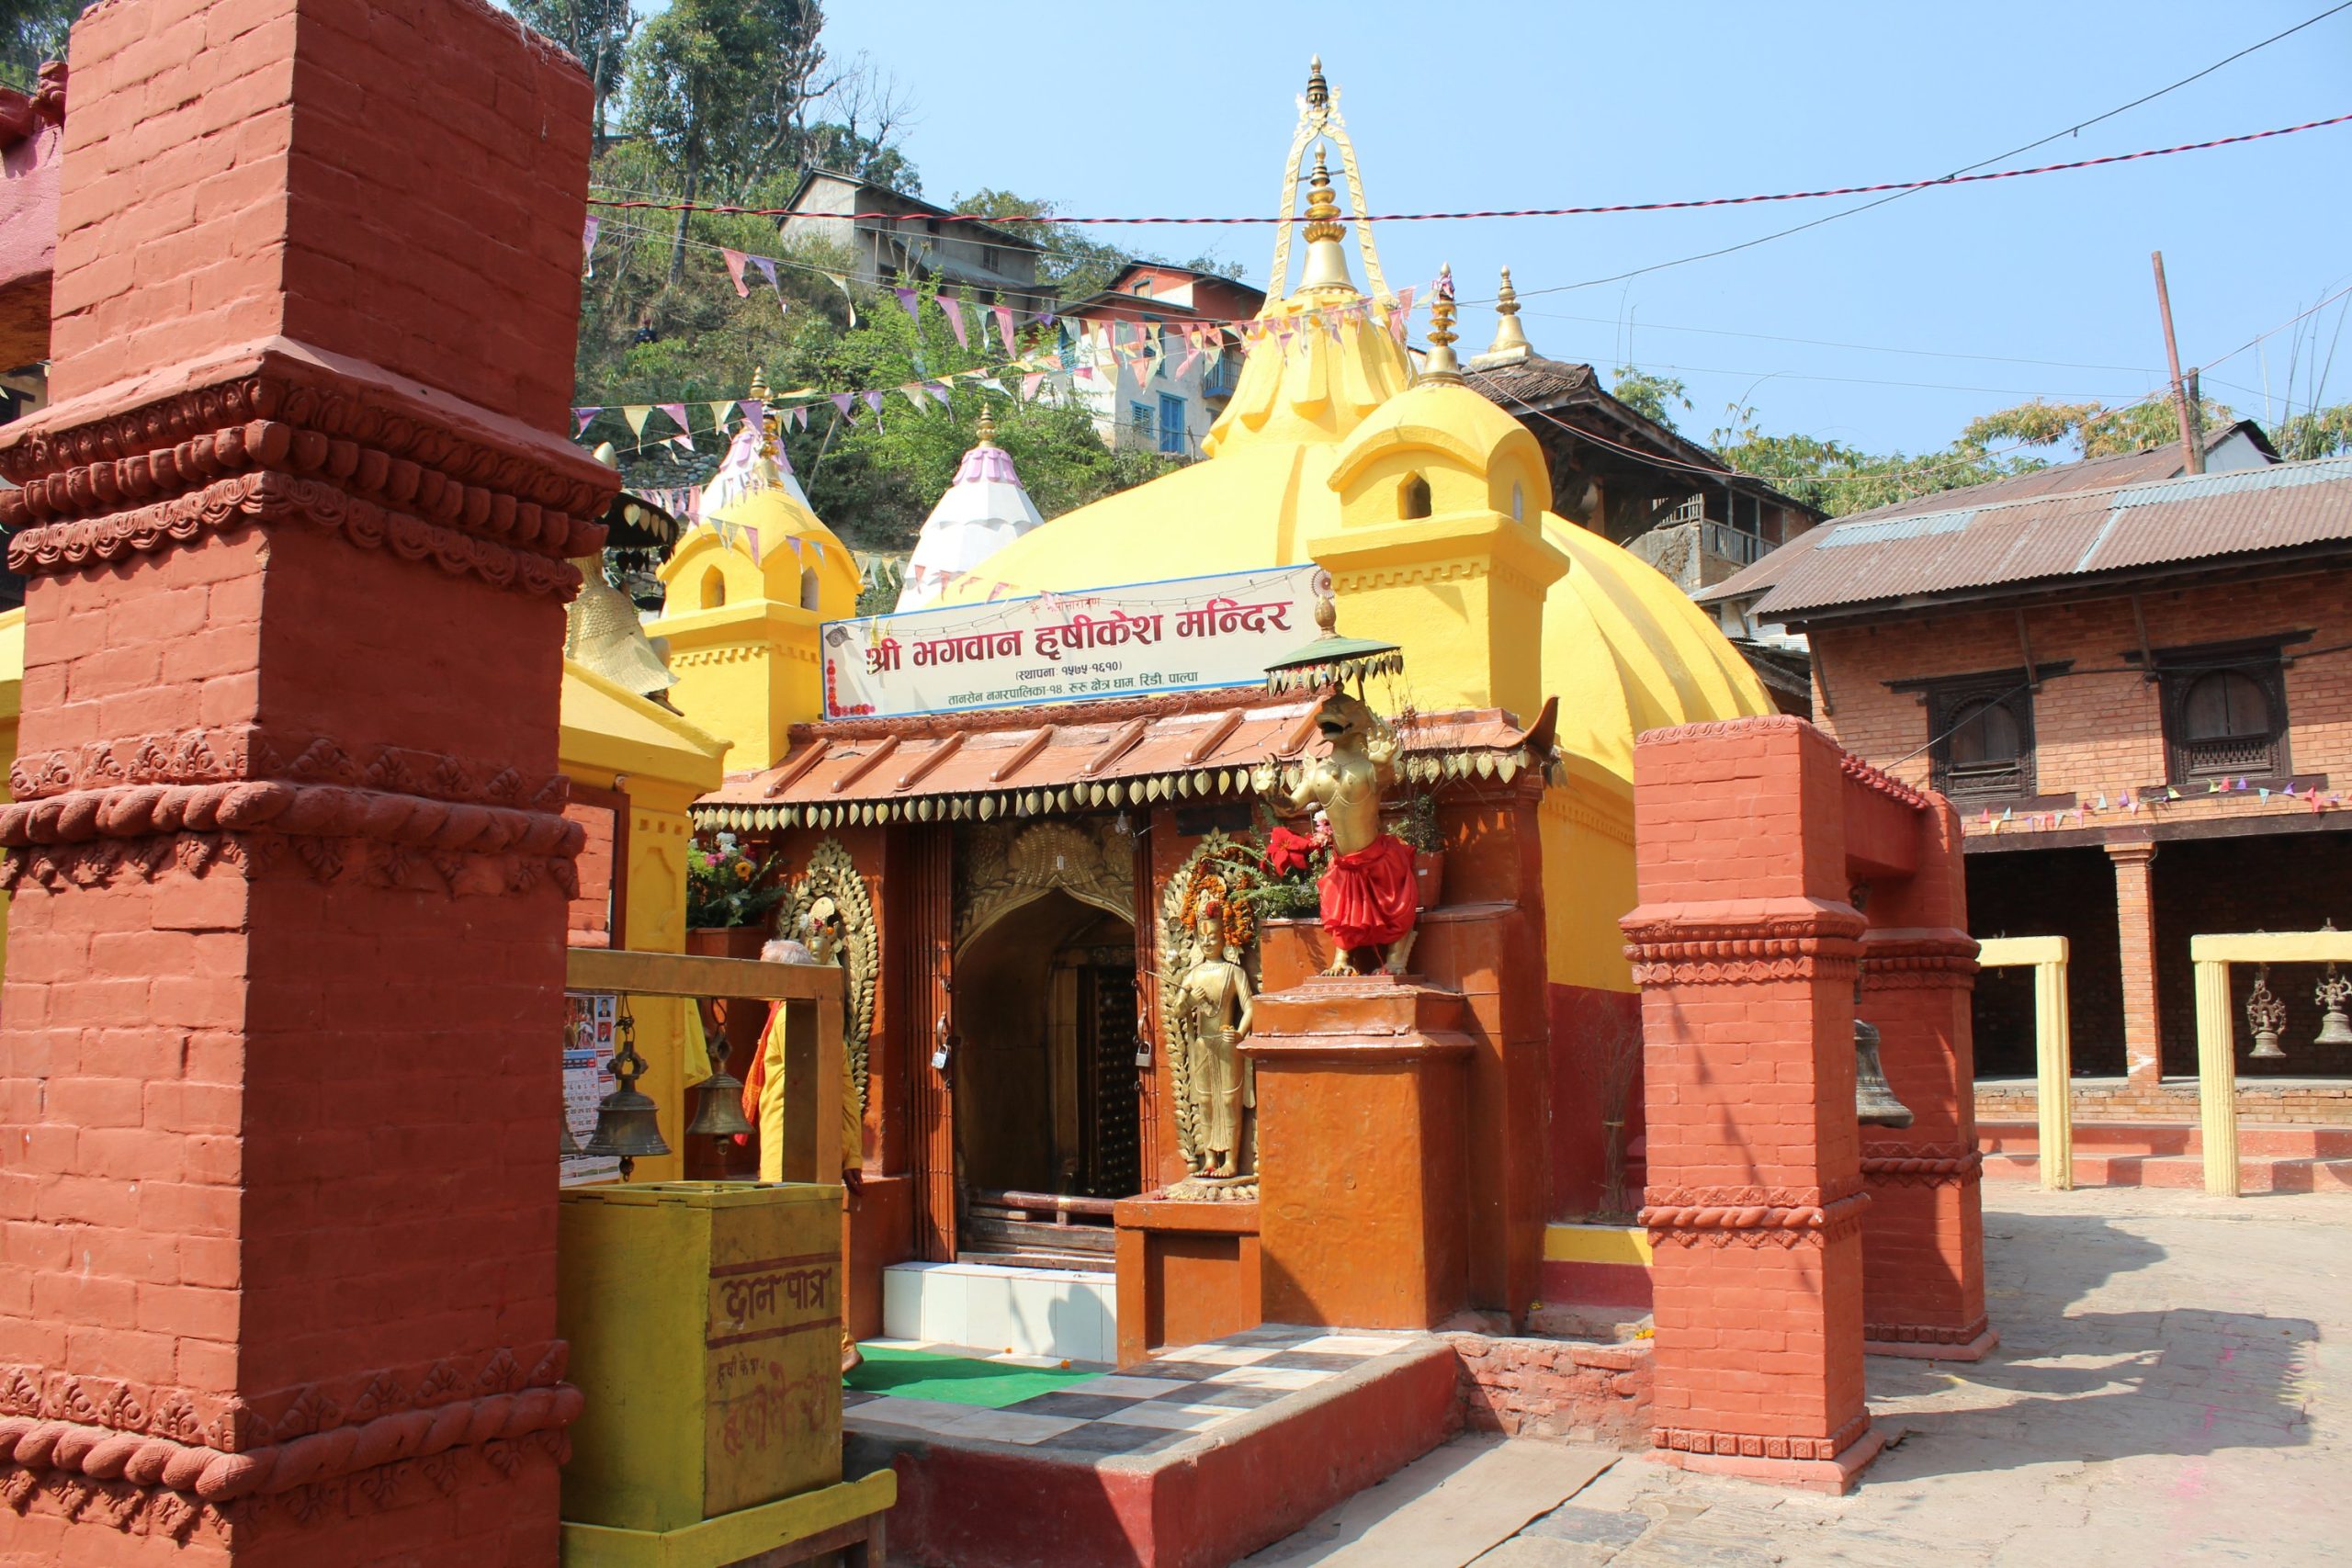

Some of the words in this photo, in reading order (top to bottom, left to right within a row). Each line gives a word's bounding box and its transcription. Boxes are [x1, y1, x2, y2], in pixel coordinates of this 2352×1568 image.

[865, 637, 902, 675] श्री
[912, 630, 1023, 667] भगवान
[1035, 610, 1164, 660] हृषीकेश
[1175, 597, 1294, 637] मन्दिर
[947, 691, 984, 705] तानसेन
[1091, 677, 1111, 692] क्षेत्र
[1169, 671, 1199, 684] पाल्पा
[721, 1275, 782, 1324] दान
[782, 1267, 832, 1310] पात्र
